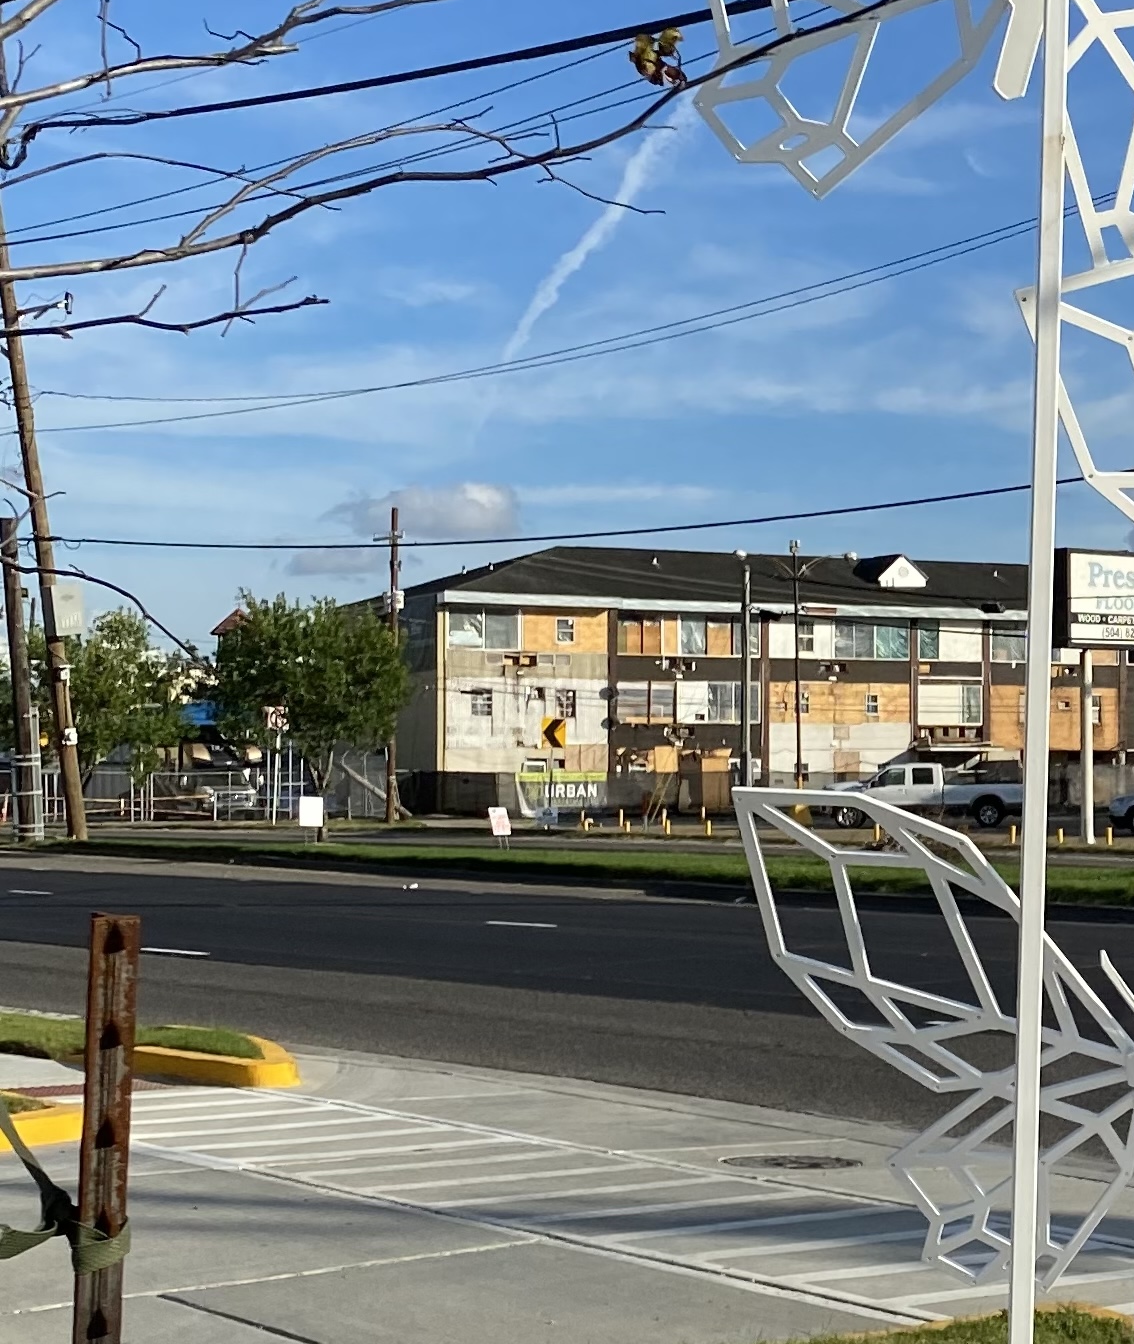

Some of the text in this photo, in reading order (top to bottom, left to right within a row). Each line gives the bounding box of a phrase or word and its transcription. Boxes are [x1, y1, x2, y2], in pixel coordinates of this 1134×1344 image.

[1078, 614, 1101, 623] WOOD
[1102, 627, 1122, 639] (504)
[544, 783, 598, 798] URBAN
